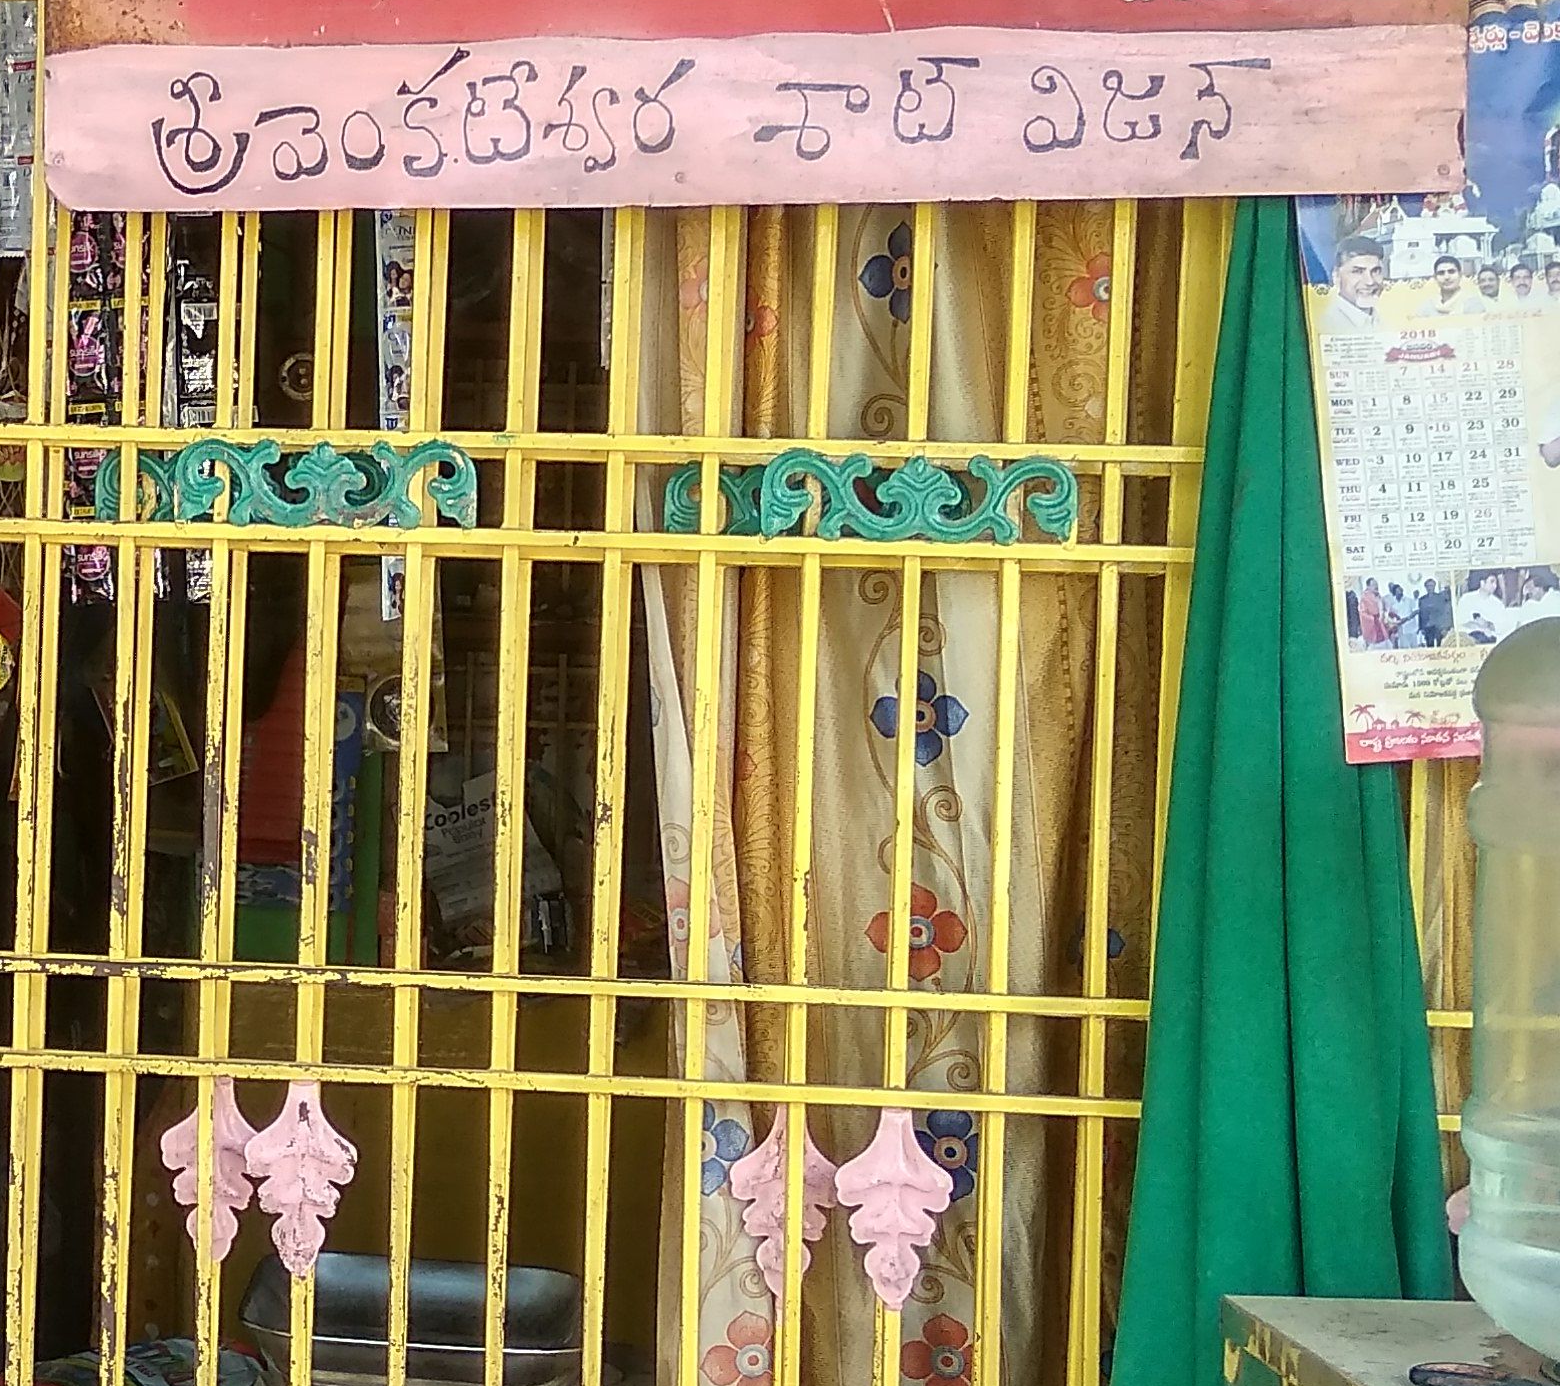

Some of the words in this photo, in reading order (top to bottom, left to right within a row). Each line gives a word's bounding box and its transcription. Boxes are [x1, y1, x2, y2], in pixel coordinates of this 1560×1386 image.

[1400, 329, 1437, 340] 2018
[1329, 371, 1350, 379] SUN
[1400, 366, 1408, 376] 7
[1430, 364, 1445, 374] 14
[1462, 362, 1479, 372] 21
[1497, 360, 1515, 370] 28
[1331, 399, 1354, 407] MON
[1370, 398, 1377, 407] 1
[1403, 396, 1411, 405] 8
[1432, 393, 1448, 404] 15
[1465, 391, 1483, 401] 22
[1499, 389, 1517, 399] 29
[1334, 428, 1355, 436] TUE
[1373, 427, 1382, 436] 2
[1405, 424, 1414, 434] 9
[1435, 422, 1451, 432] 16
[1466, 420, 1485, 430] 23
[1501, 418, 1520, 428] 30
[1335, 458, 1360, 466] WED
[1376, 455, 1384, 465] 3
[1405, 453, 1422, 463] 10
[1437, 451, 1453, 461] 17
[1469, 449, 1487, 460] 24
[1503, 447, 1520, 458] 31
[1340, 485, 1362, 494] THU
[1378, 484, 1387, 494] 4
[1407, 482, 1422, 492] 11
[1439, 480, 1456, 491] 18
[1472, 478, 1490, 488] 25
[1344, 514, 1362, 523] FRI
[1381, 513, 1390, 523] 5
[1409, 512, 1425, 522] 12
[1442, 510, 1459, 520] 19
[1474, 508, 1492, 519] 26
[1346, 545, 1366, 554] SAT
[1384, 542, 1393, 553] 6
[1412, 541, 1428, 551] 13
[1444, 539, 1462, 549] 20
[1477, 537, 1495, 548] 27
